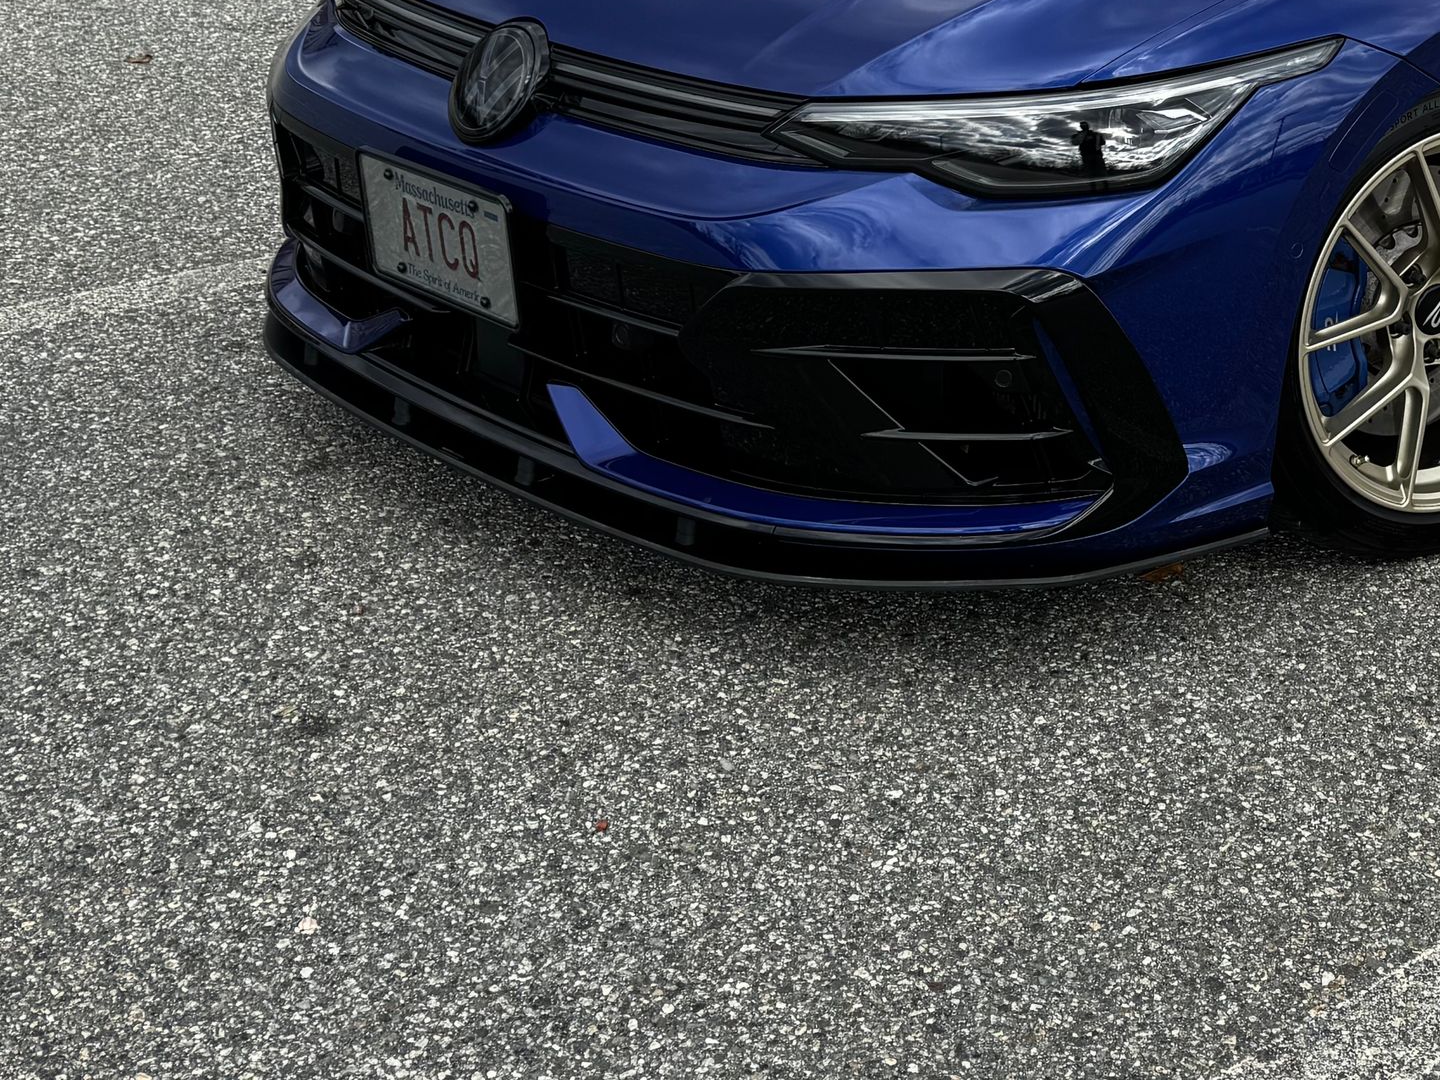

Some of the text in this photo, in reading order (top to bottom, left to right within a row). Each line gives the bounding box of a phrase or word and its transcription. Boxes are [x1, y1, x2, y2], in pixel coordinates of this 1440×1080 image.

[1422, 100, 1440, 113] ALL
[402, 197, 480, 281] ATCQ
[408, 262, 481, 303] The Spirit of Americ
